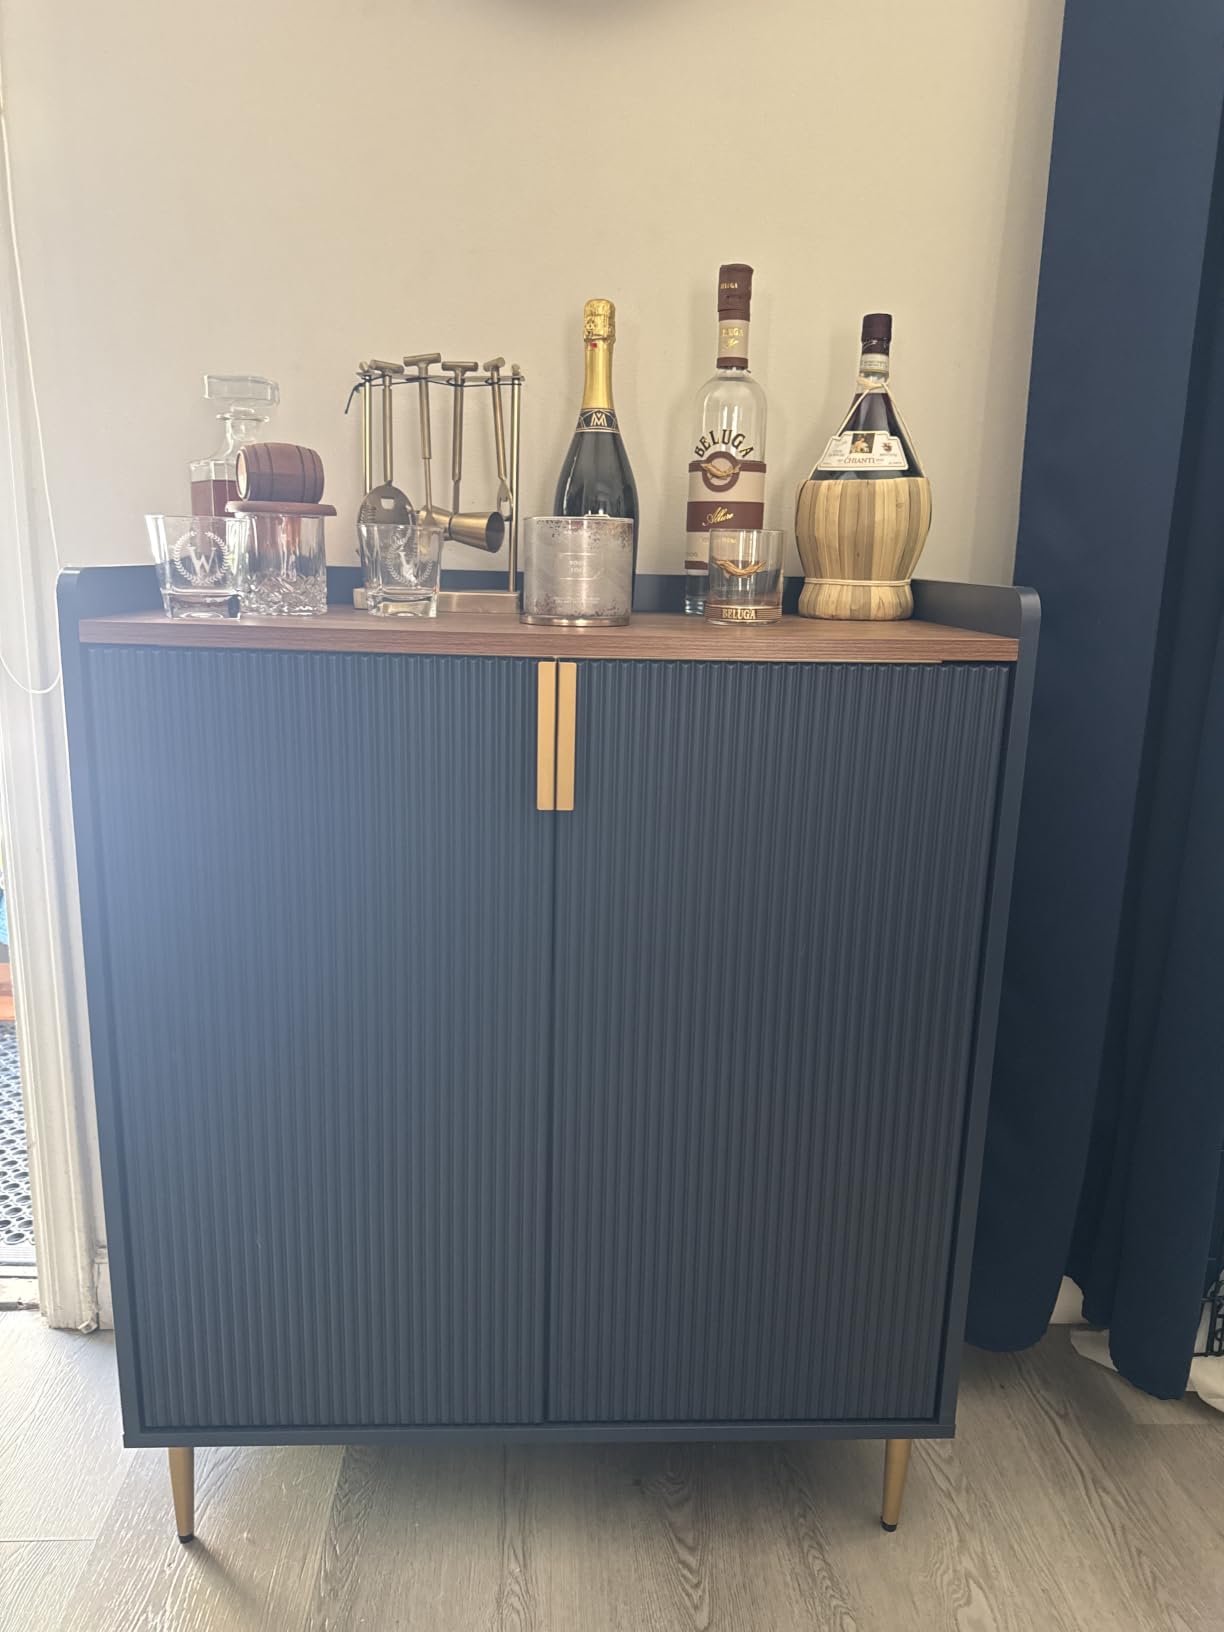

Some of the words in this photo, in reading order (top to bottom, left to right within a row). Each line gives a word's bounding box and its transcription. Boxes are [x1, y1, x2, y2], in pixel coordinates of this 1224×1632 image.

[694, 429, 755, 458] BELUGA
[843, 456, 876, 464] CHIANTI
[187, 546, 217, 574] W
[721, 608, 757, 620] BELUGA
